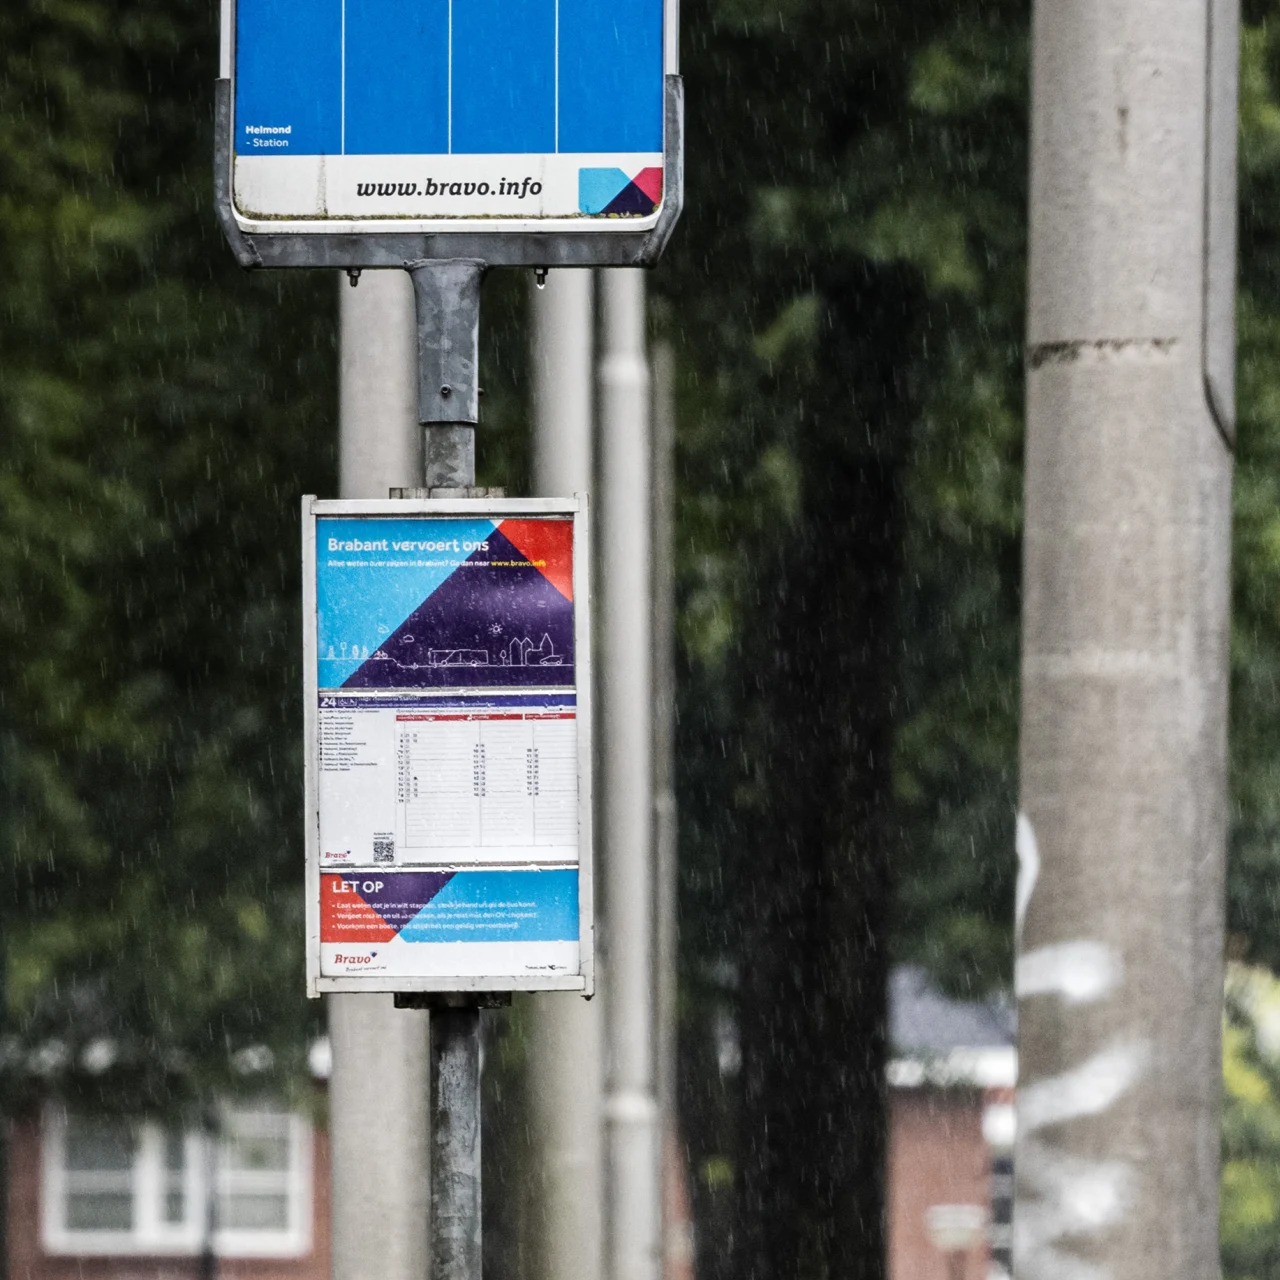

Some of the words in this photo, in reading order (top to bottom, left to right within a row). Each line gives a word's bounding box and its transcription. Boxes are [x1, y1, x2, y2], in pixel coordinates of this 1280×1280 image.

[245, 125, 292, 134] Helmond
[253, 138, 289, 147] Station
[356, 177, 543, 199] www.bravo.info
[327, 538, 389, 551] Brabant
[392, 539, 460, 552] vervoert
[462, 540, 490, 551] ons
[491, 559, 546, 567] www.bravo.info
[320, 698, 337, 707] 24
[332, 881, 359, 893] LET
[362, 881, 385, 893] OP
[334, 954, 371, 964] Bravo
